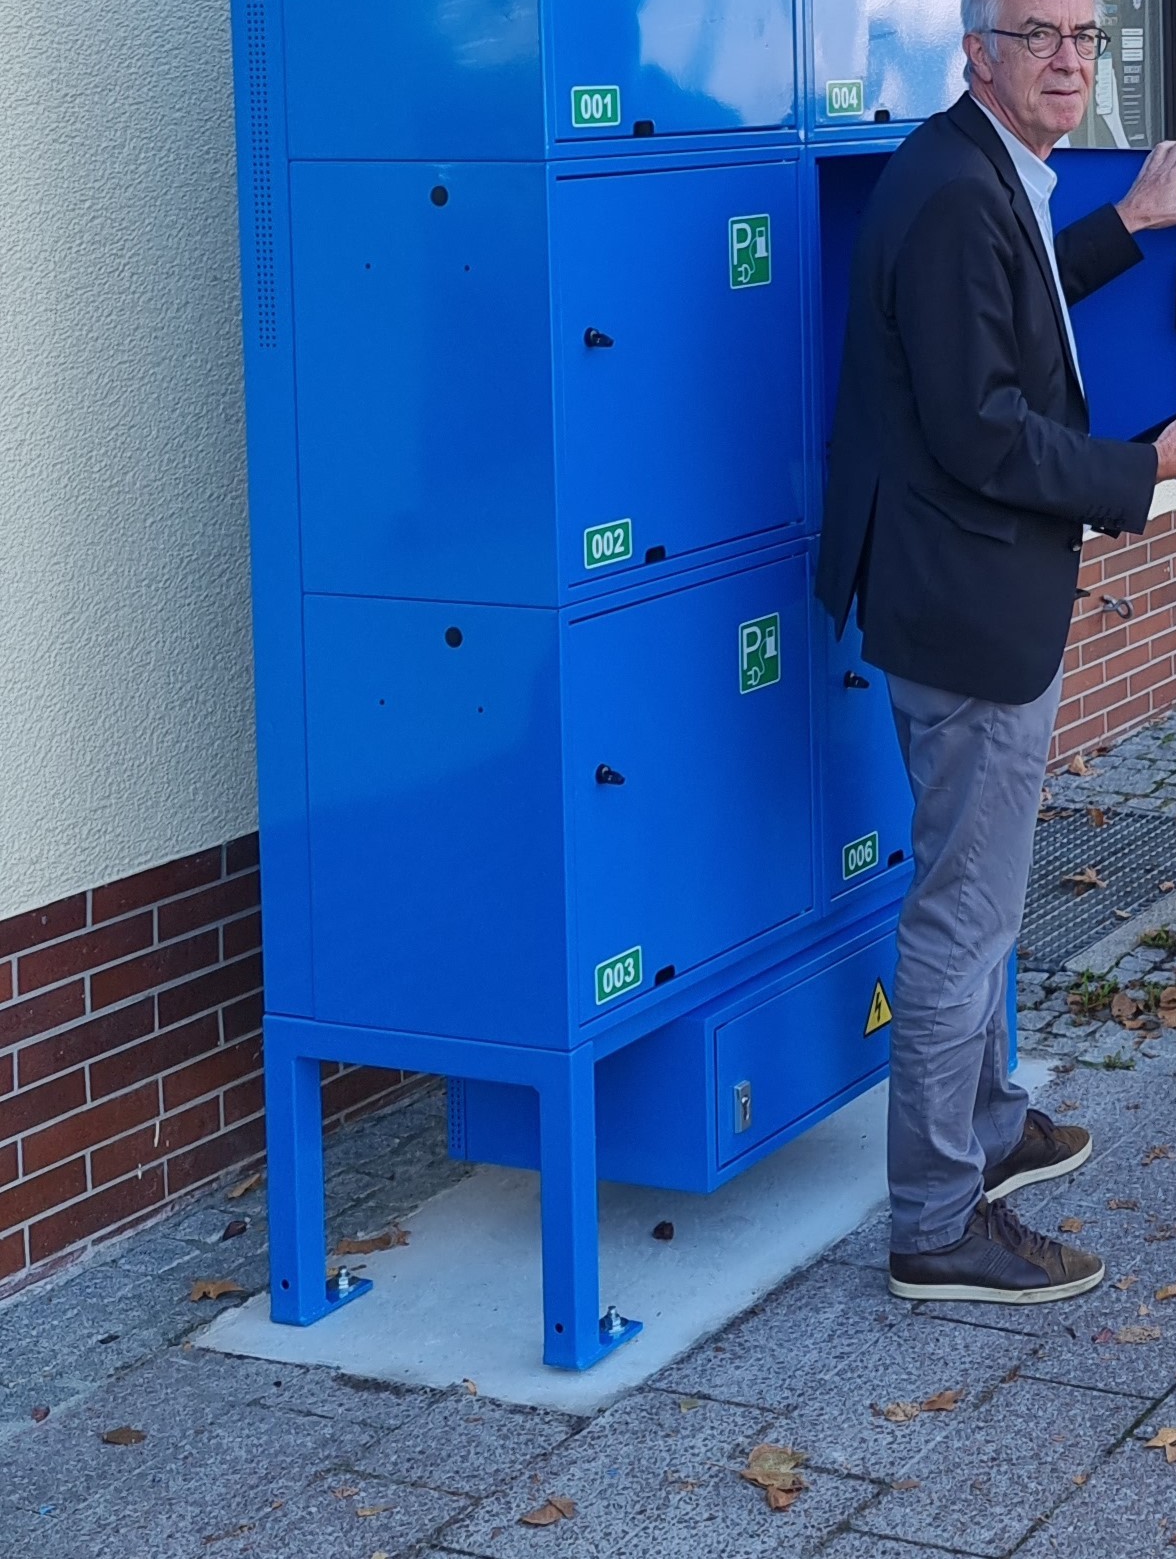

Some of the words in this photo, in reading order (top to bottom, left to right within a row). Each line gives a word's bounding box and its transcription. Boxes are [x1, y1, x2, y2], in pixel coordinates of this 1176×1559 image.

[580, 93, 612, 120] 001
[832, 86, 859, 109] 004
[591, 528, 625, 559] 002
[848, 840, 873, 871] 006
[602, 957, 635, 994] 003
